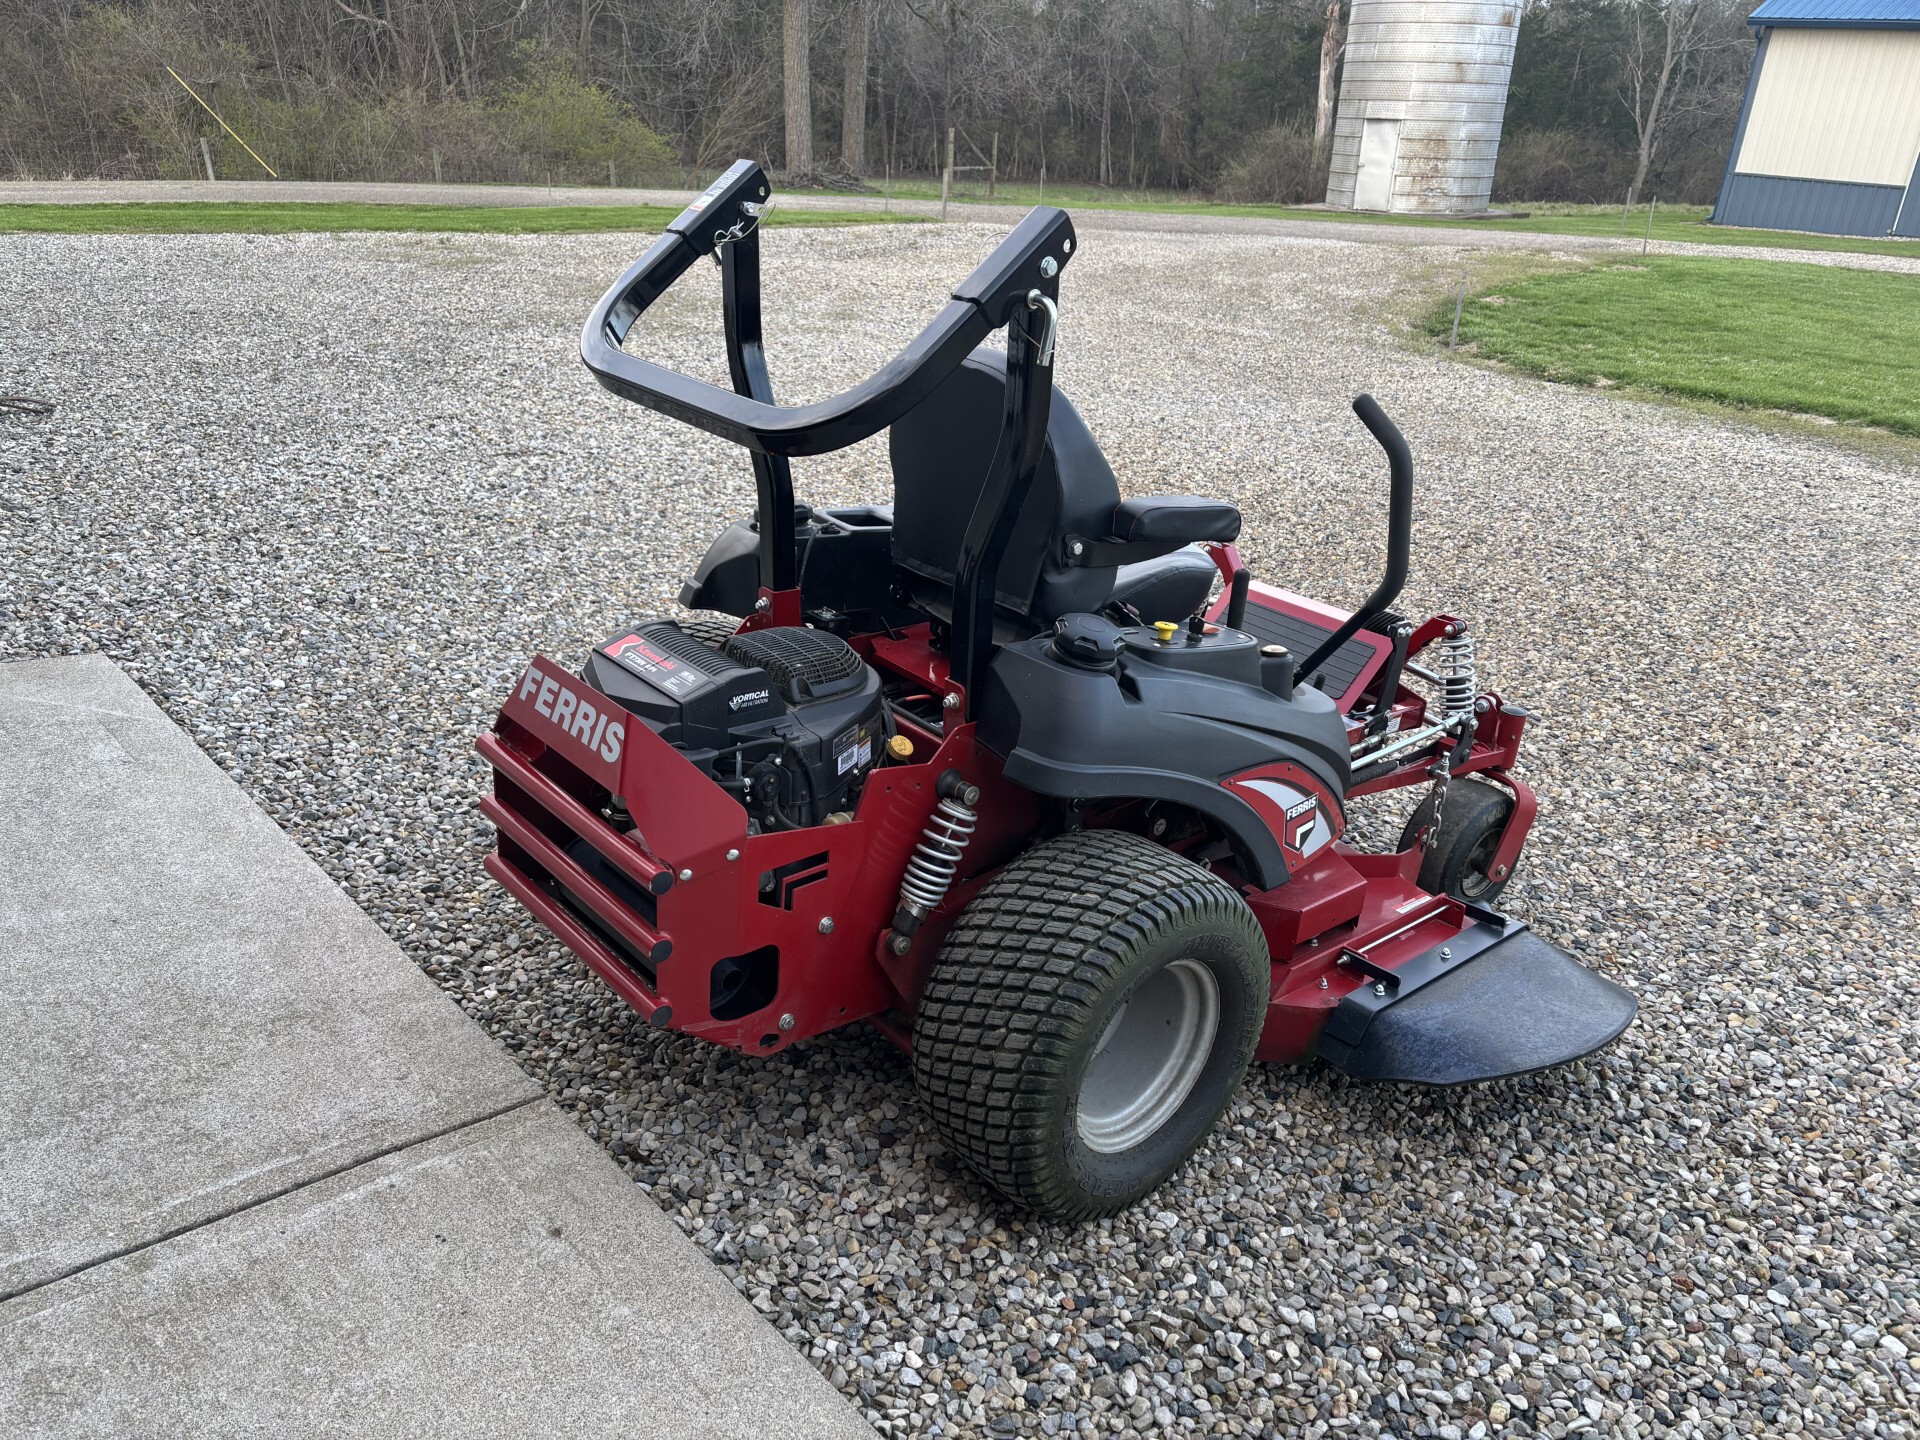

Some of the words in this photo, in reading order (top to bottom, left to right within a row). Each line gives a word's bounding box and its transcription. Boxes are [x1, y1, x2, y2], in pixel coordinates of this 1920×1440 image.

[732, 689, 769, 703] VORTICAL
[518, 665, 625, 763] FERRIS
[1286, 796, 1317, 821] FERRIS
[1184, 931, 1242, 955] TURF
